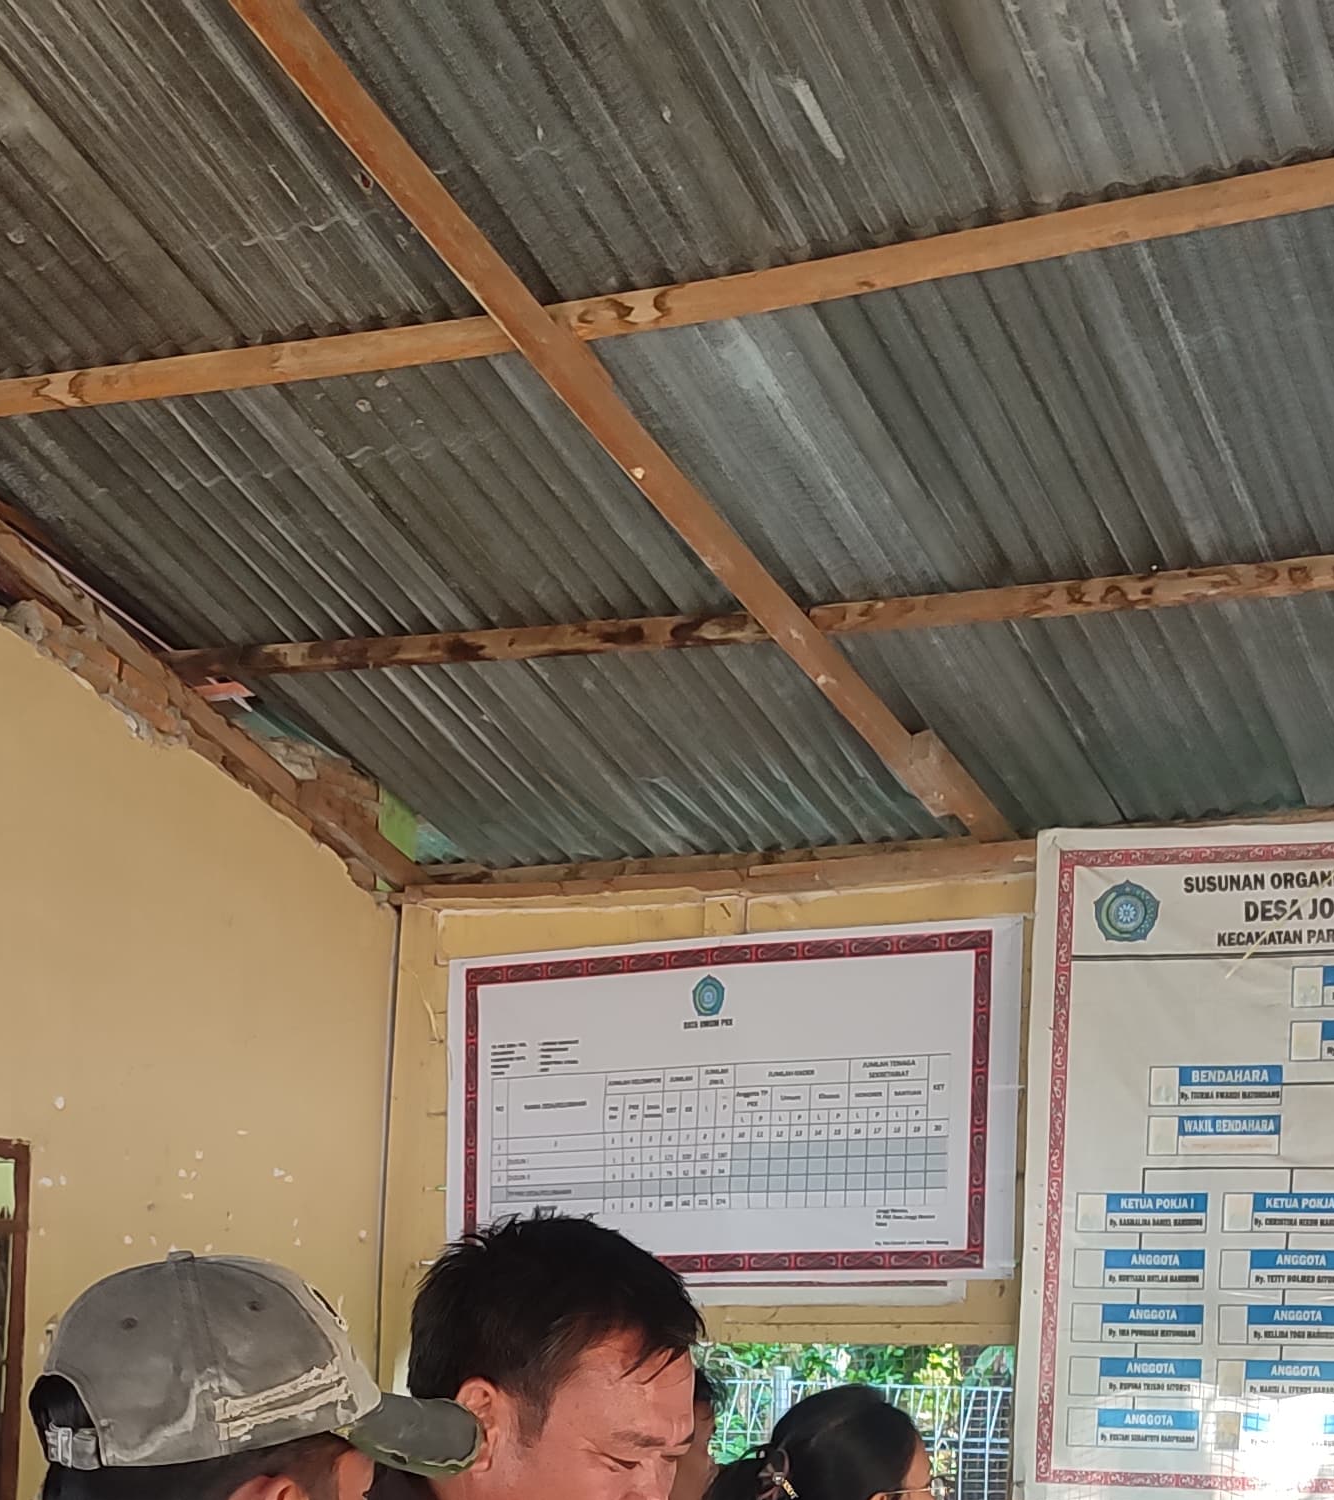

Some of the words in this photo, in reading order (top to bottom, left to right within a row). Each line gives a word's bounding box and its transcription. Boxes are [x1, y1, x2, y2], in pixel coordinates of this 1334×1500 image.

[1184, 874, 1265, 894] SUSUNAN
[1245, 899, 1303, 922] DESA
[1217, 928, 1303, 948] KECAMATAN
[1192, 1070, 1269, 1083] BENDAHARA
[1184, 1120, 1214, 1132] WAKIL
[1215, 1119, 1275, 1132] BENDAHARA
[1120, 1198, 1154, 1210] KETUA
[1155, 1197, 1188, 1210] POKJA
[1190, 1198, 1195, 1209] I
[1265, 1198, 1299, 1209] KETUA
[1301, 1197, 1334, 1209] POKJA
[1131, 1254, 1180, 1266] ANGGOTA
[1275, 1254, 1327, 1266] ANGGOTA
[1129, 1309, 1177, 1320] ANGGOTA
[1274, 1309, 1322, 1321] ANGGOTA
[1126, 1362, 1175, 1374] ANGGOTA
[1271, 1365, 1320, 1377] ANGGOTA
[1124, 1414, 1173, 1426] ANGGOTA
